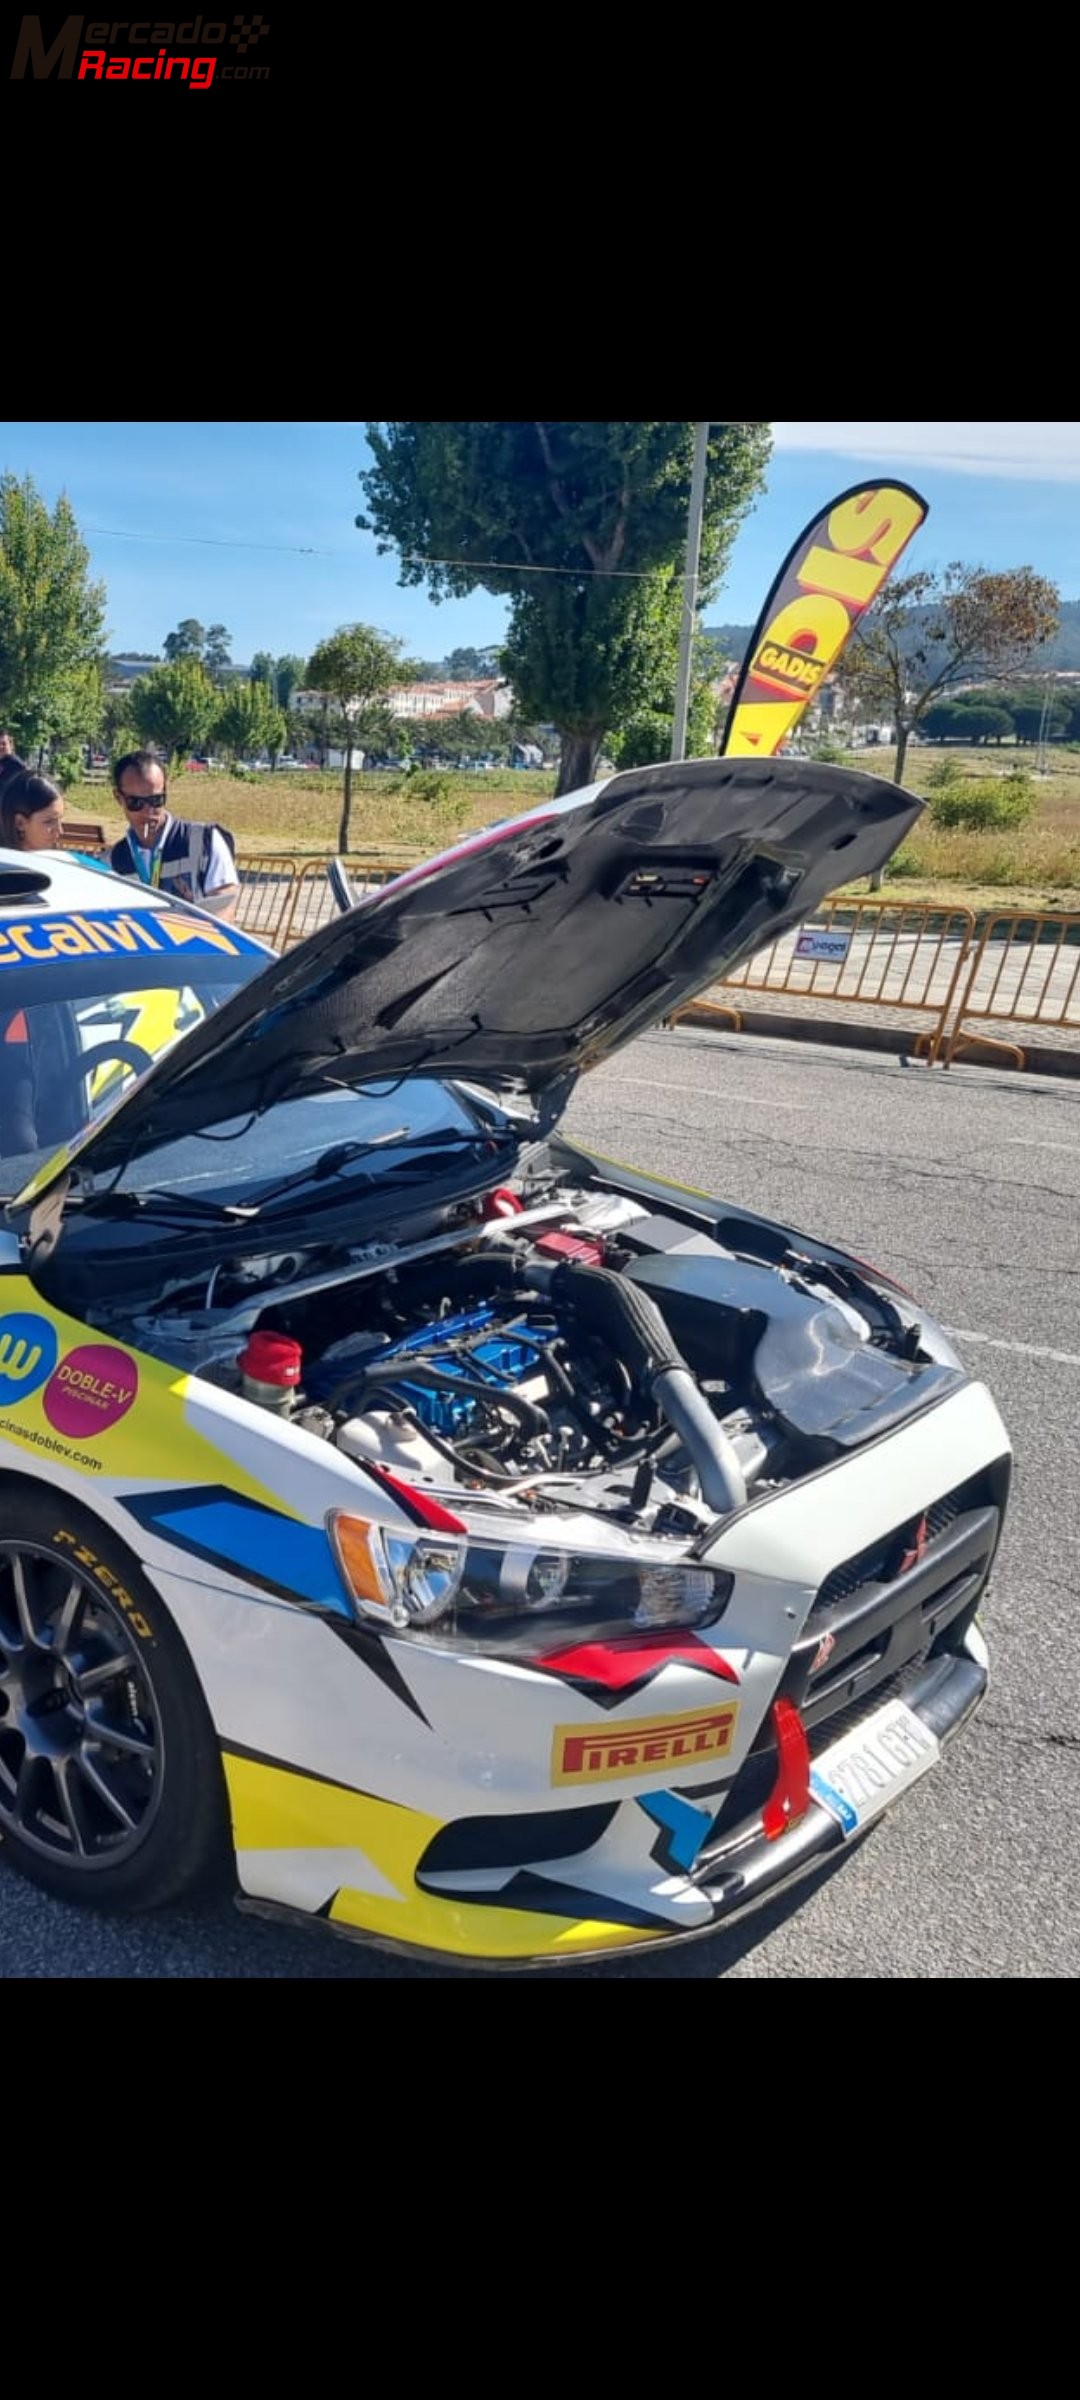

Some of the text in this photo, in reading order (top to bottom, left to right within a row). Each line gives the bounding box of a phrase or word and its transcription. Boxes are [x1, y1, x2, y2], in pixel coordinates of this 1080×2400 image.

[760, 648, 824, 684] GADIS
[57, 1365, 132, 1404] DOBLE-V
[0, 1418, 102, 1471] cinasdoblev.com
[74, 1545, 153, 1638] ZERO
[562, 1713, 733, 1773] PIRELLI
